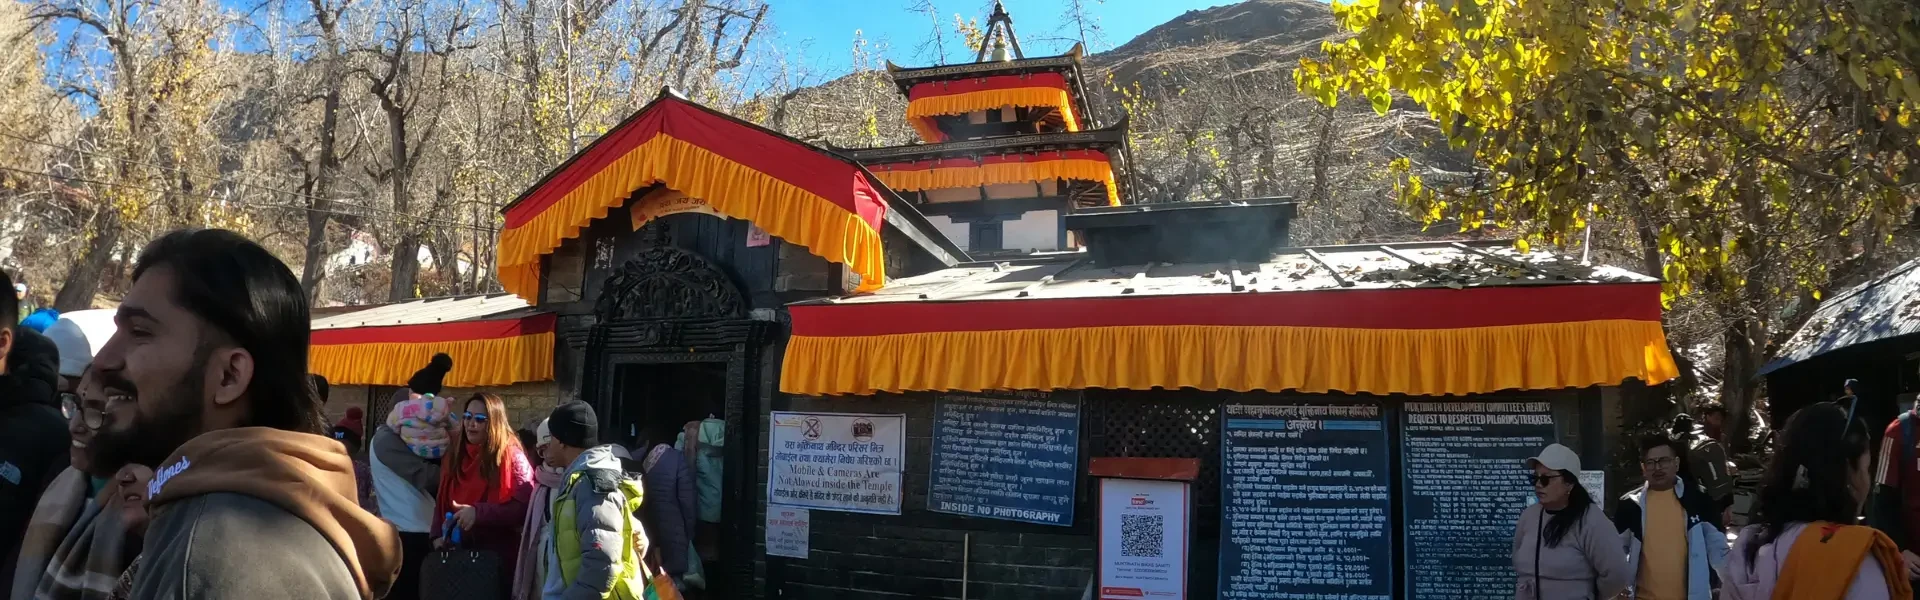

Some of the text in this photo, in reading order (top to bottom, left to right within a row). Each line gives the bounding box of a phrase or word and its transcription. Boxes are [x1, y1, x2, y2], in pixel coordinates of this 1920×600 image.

[1443, 402, 1486, 413] DEVELOPMENT
[1526, 402, 1551, 413] HEARTY
[1408, 414, 1437, 424] REQUEST
[1439, 414, 1448, 424] TO
[1448, 414, 1486, 425] RESPECTED
[857, 454, 882, 466] गरिएको
[790, 464, 880, 479] Mobile & Cameras Are
[822, 478, 846, 489] inside
[847, 480, 861, 490] the
[862, 479, 893, 494] Temple
[940, 501, 1061, 523] INSIDE NO PHOTOGRAPHY
